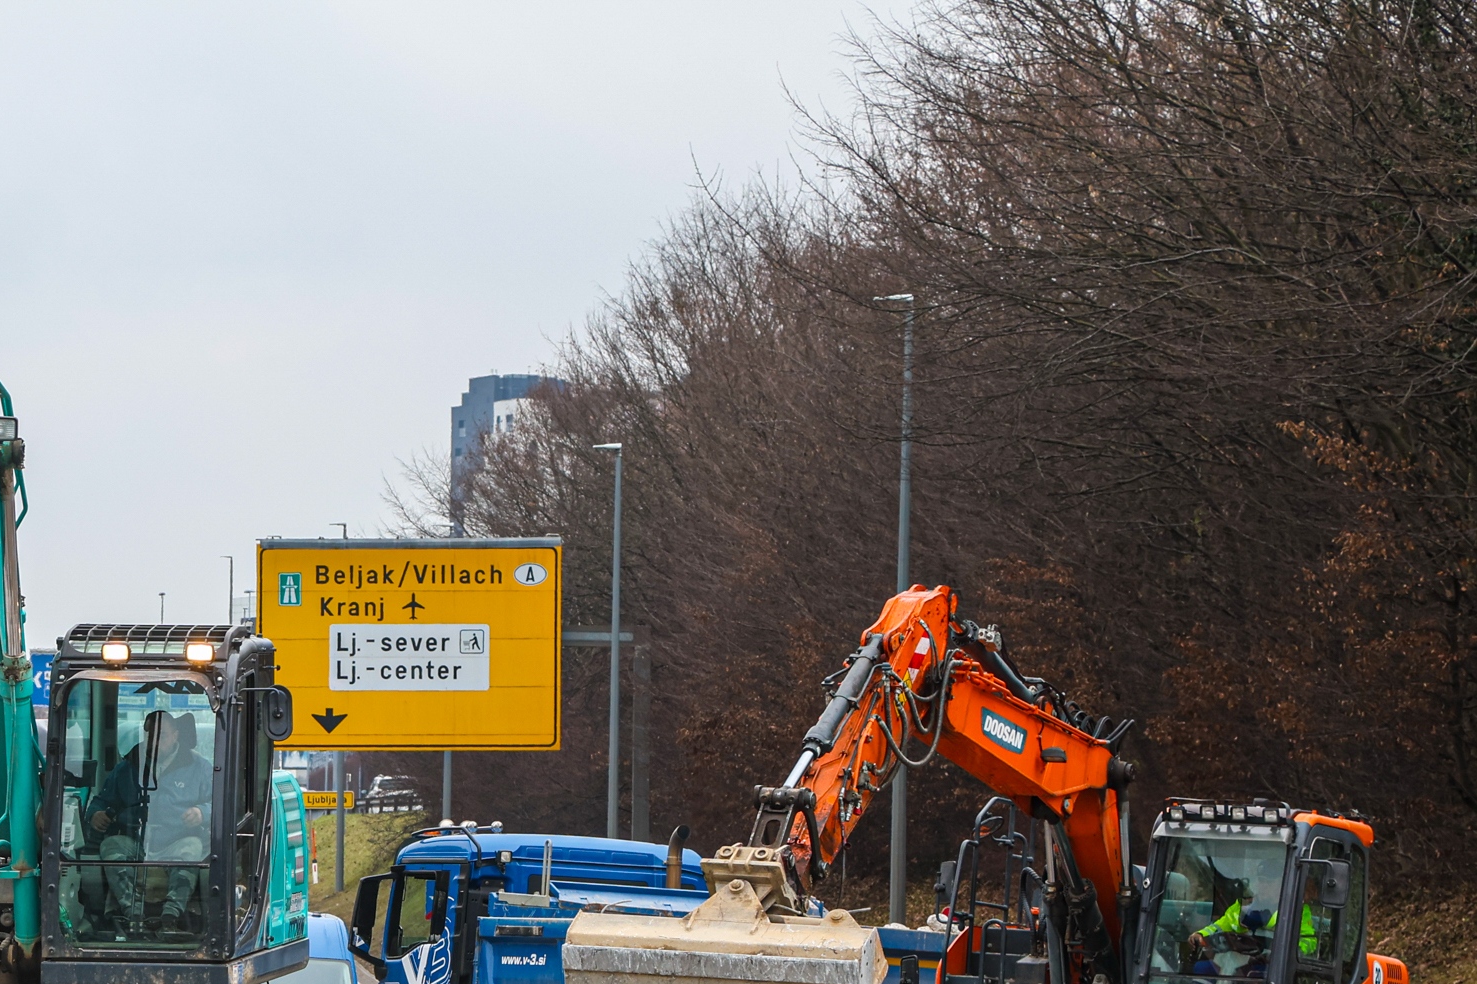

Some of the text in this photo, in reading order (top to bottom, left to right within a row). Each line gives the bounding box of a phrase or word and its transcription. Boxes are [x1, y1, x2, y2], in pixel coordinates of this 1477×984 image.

[315, 561, 503, 589] Beljak/Villach
[525, 566, 535, 583] A
[320, 597, 385, 621] Kranj
[984, 715, 1024, 749] DOOSAN
[307, 795, 348, 806] Ljubljaa
[501, 953, 547, 966] www.v-3.si
